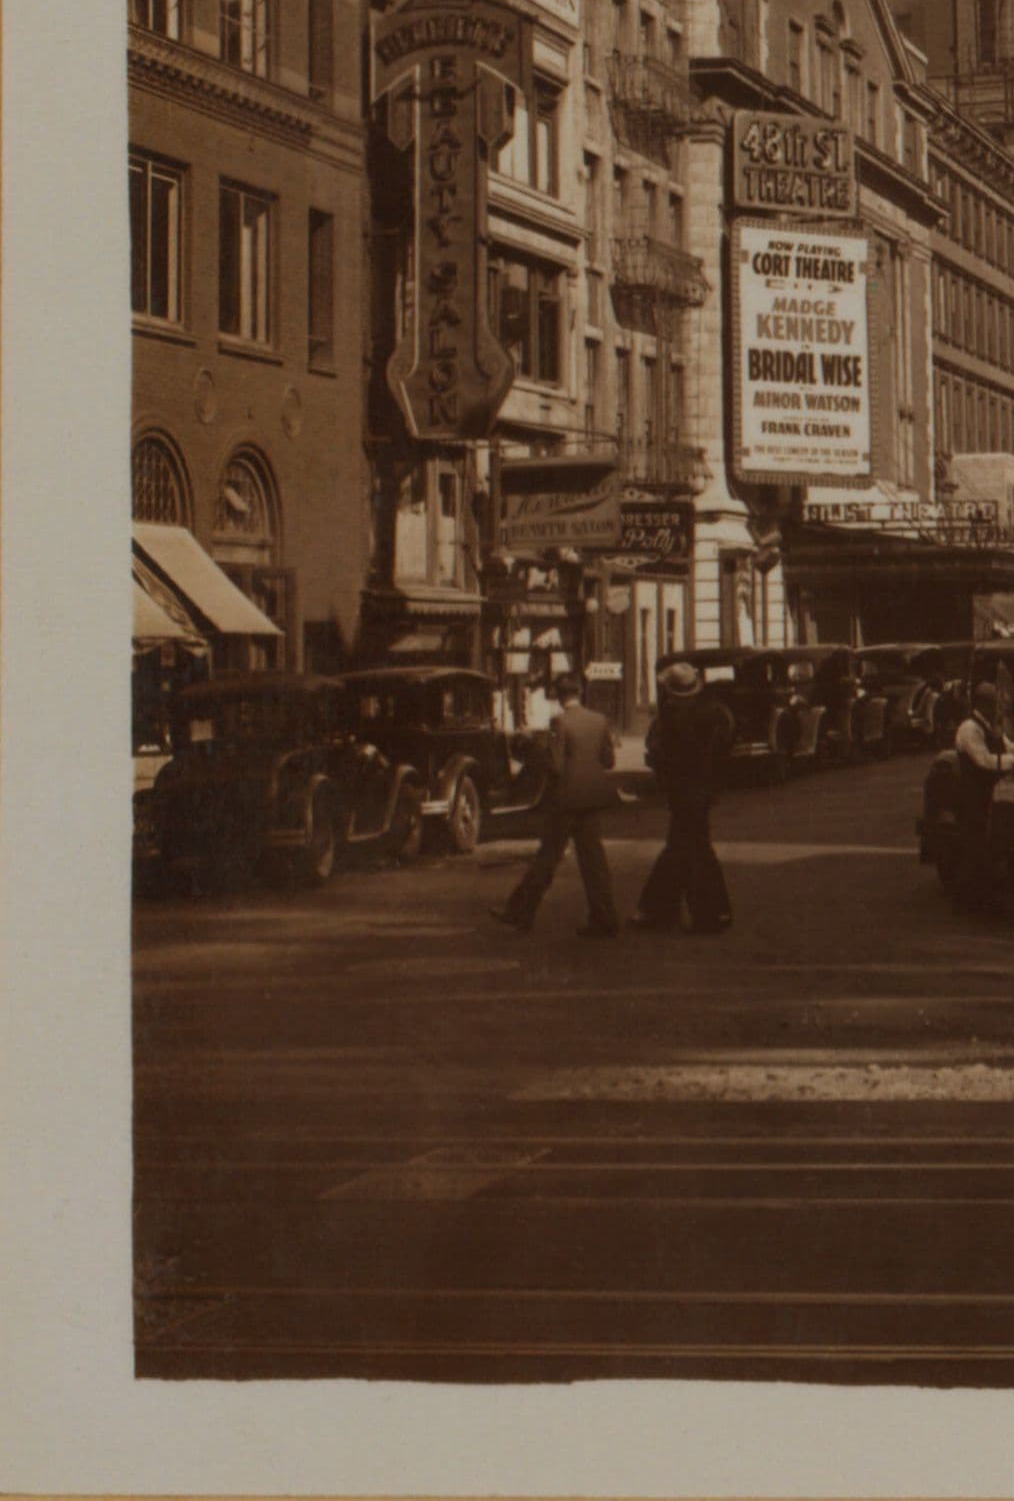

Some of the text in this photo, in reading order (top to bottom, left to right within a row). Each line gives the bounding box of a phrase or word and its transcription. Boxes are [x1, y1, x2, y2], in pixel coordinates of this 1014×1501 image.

[743, 165, 852, 213] THEATRE
[767, 240, 841, 258] NOW PLAYING
[752, 253, 855, 284] CORT THEATRE
[772, 296, 837, 317] MADGE
[756, 313, 856, 346] KENNEDY
[427, 261, 462, 429] SALON
[748, 347, 862, 388] BRIDAL WISE
[753, 390, 861, 413] MINOR WATSON
[761, 421, 851, 439] FRANK CRAVEN
[887, 500, 994, 522] THEATRE
[570, 520, 615, 535] SALON
